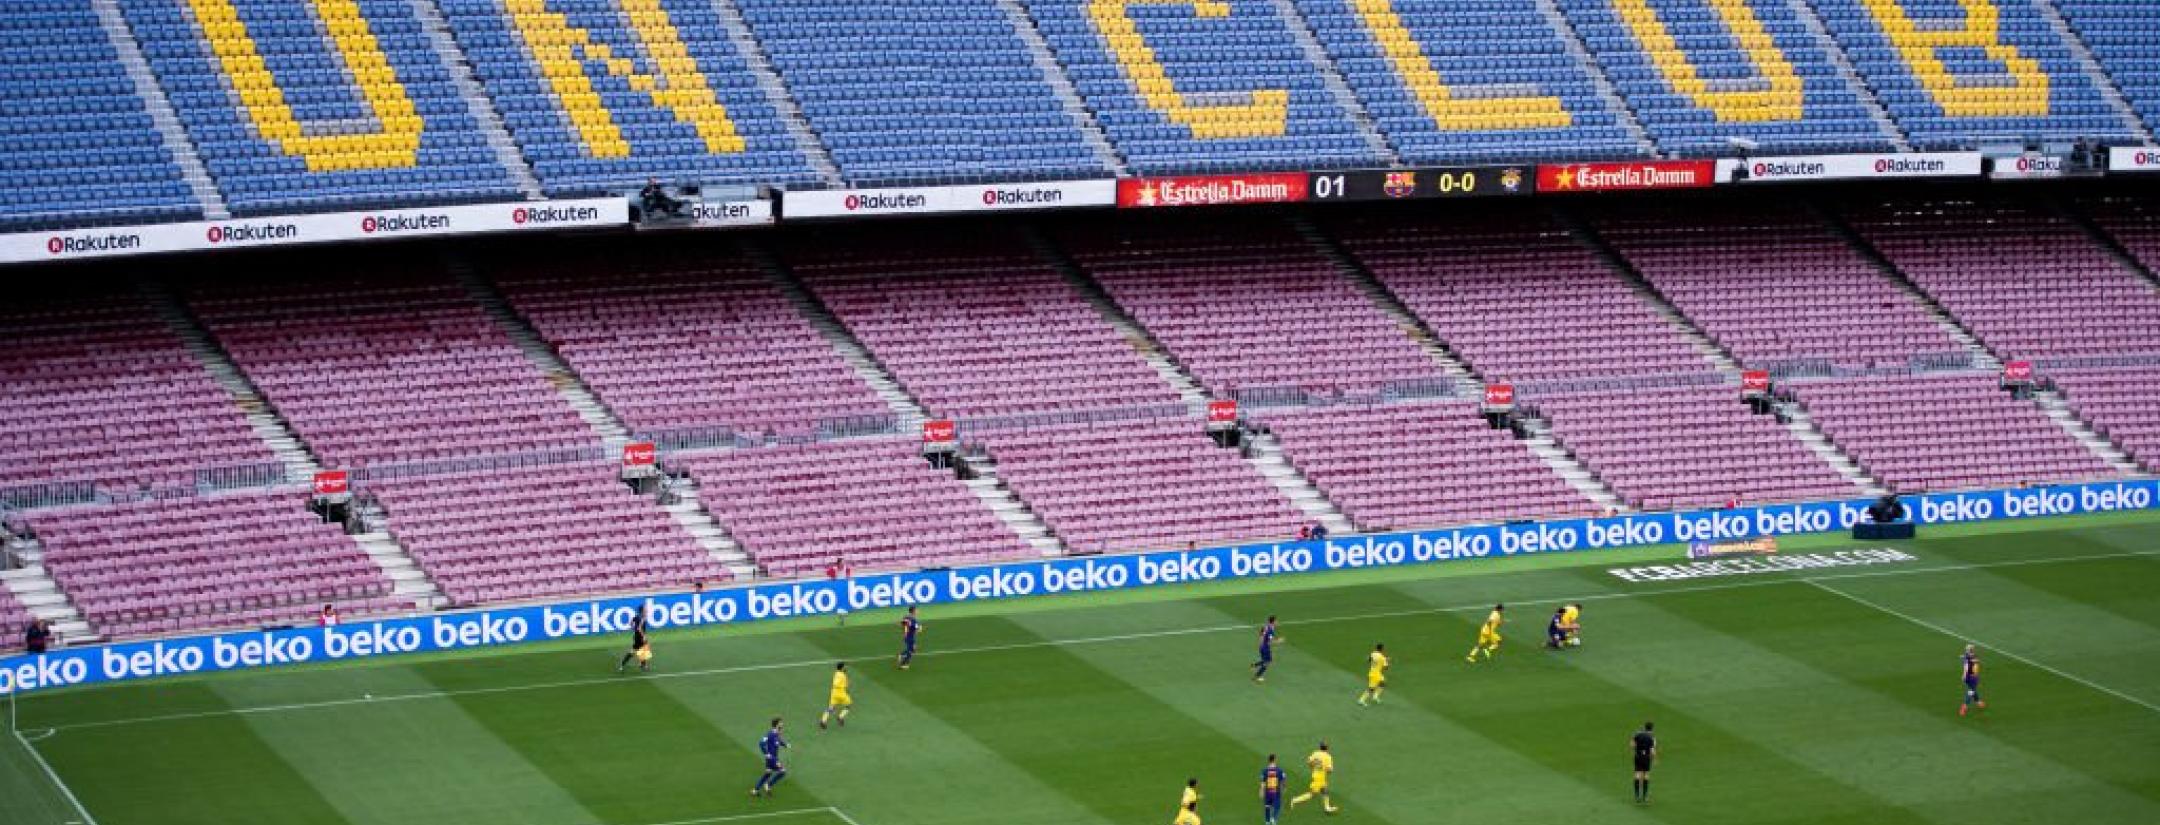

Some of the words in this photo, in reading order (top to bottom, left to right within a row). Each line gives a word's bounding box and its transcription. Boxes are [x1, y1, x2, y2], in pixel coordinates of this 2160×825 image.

[1767, 162, 1825, 176] Rakuten
[1887, 158, 1945, 173] Rakuten
[1440, 172, 1475, 192] 0-0
[1577, 168, 1640, 187] Estrella
[1643, 166, 1695, 185] Damm
[997, 187, 1062, 204] Rakuten
[1161, 179, 1228, 202] Estrella
[1231, 179, 1288, 199] Damm
[1315, 175, 1345, 198] 01
[859, 192, 926, 210] Rakuten
[528, 205, 598, 223] Rakuten
[692, 203, 750, 220] akuten
[377, 213, 450, 232] Rakuten
[223, 223, 297, 242] Rakuten
[64, 233, 140, 253] Rakuten
[103, 642, 203, 679] beko
[214, 632, 312, 668] beko
[324, 622, 421, 658] beko
[434, 612, 527, 647] beko
[544, 602, 637, 637] beko
[645, 593, 737, 628] beko
[749, 585, 837, 618] beko
[848, 576, 936, 608] beko
[949, 568, 1035, 600] beko
[1044, 559, 1128, 592] beko
[1139, 552, 1221, 584] beko
[1232, 544, 1313, 576] beko
[1326, 537, 1406, 568] beko
[1413, 530, 1492, 561] beko
[1500, 523, 1578, 554] beko
[1587, 517, 1663, 547] beko
[1675, 510, 1750, 541] beko
[1757, 504, 1832, 535] beko
[1921, 494, 1993, 523] beko
[2004, 489, 2075, 517] beko
[2082, 483, 2150, 511] beko
